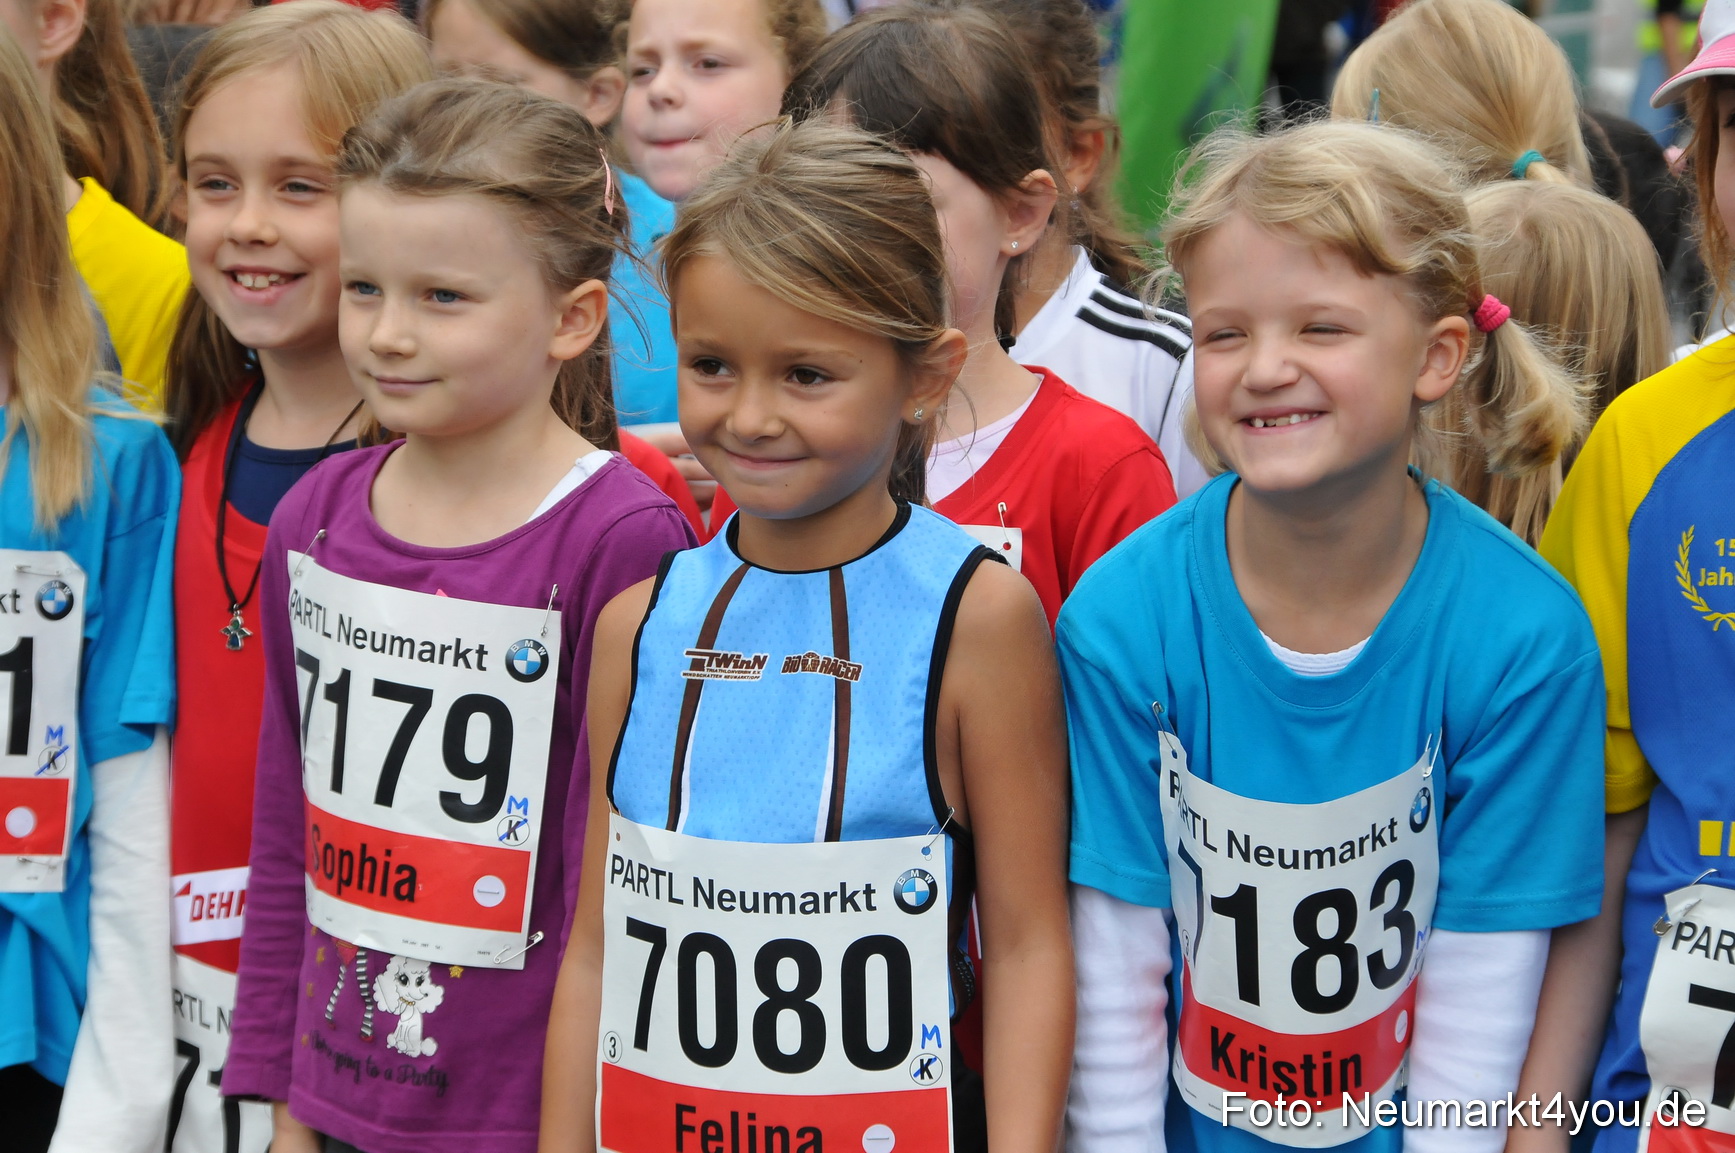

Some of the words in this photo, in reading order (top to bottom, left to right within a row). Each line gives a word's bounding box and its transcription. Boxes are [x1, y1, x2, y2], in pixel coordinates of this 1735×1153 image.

[289, 589, 332, 639] PARTL
[337, 613, 489, 672] Neumarkt
[45, 725, 64, 746] M
[296, 647, 514, 824] 7179
[507, 795, 529, 816] M
[311, 823, 418, 903] Sophia
[1227, 817, 1398, 871] Neumarkt
[610, 854, 684, 905] PARTL
[693, 876, 877, 915] Neumarkt
[626, 916, 913, 1075] 7080
[608, 1037, 617, 1059] 3
[920, 1024, 942, 1049] M
[1210, 1025, 1363, 1097] Kristin
[919, 1058, 934, 1081] K
[674, 1103, 823, 1153] Felina
